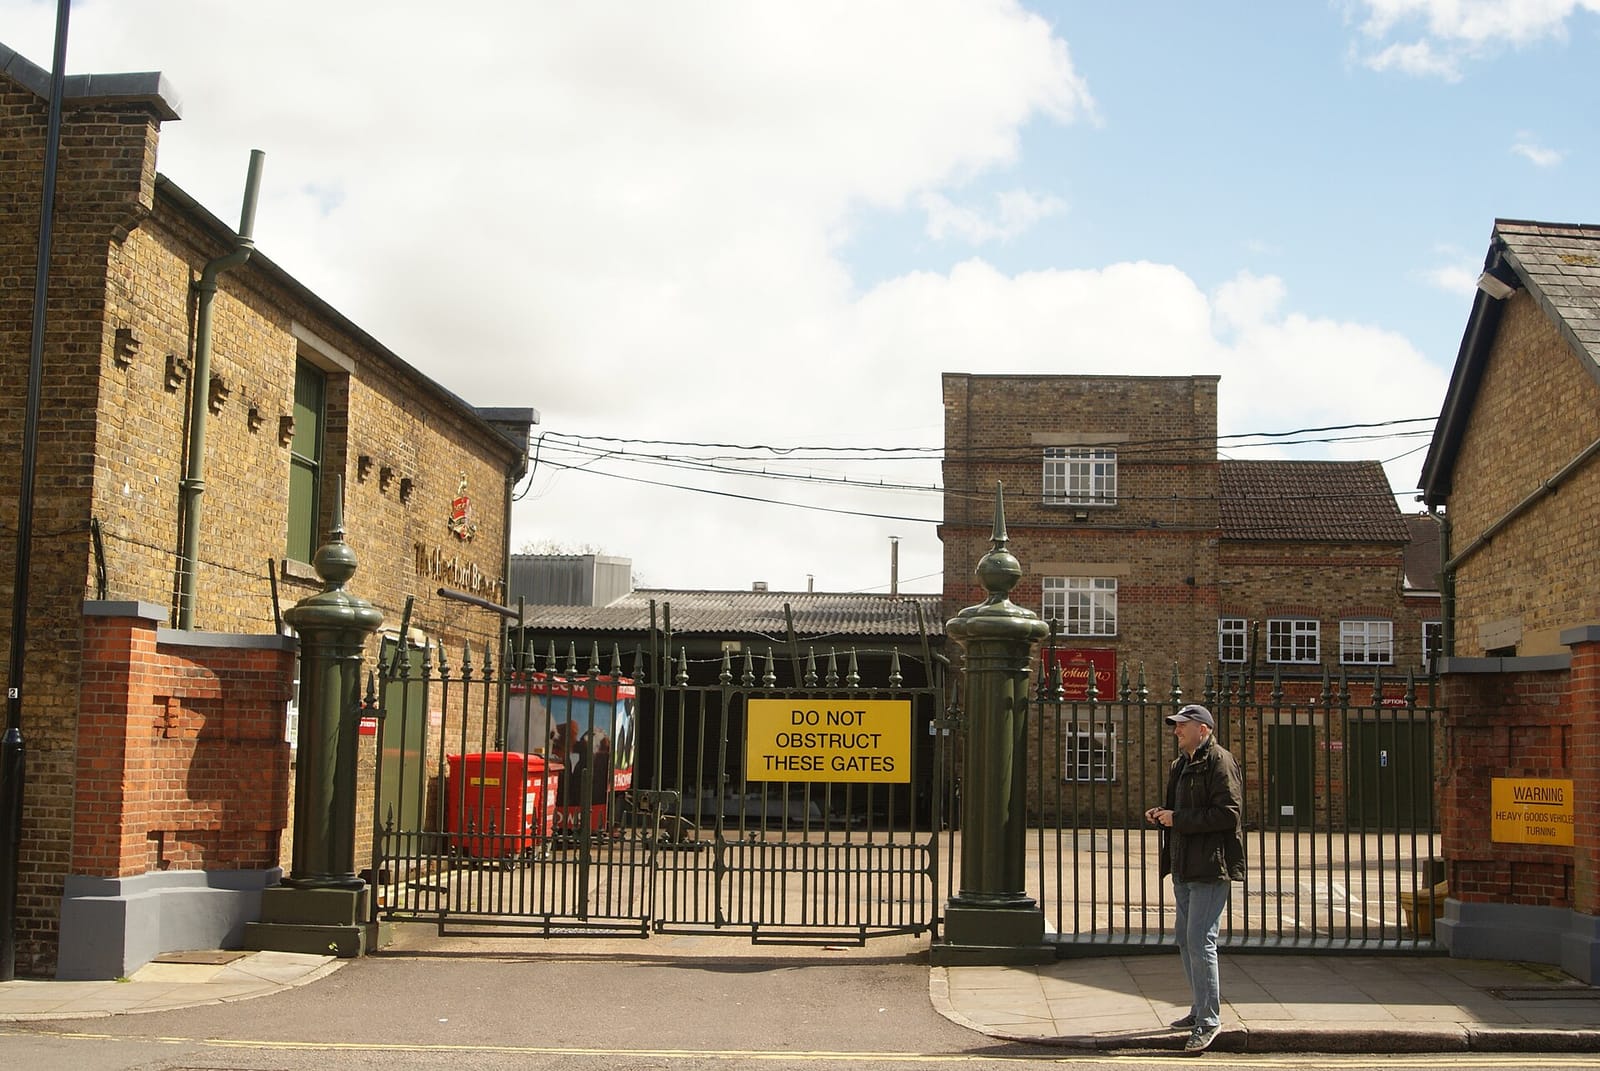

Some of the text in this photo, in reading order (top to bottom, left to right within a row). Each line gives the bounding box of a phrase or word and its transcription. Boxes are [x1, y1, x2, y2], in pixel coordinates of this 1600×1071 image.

[791, 710, 866, 726] DO NOT
[776, 733, 882, 749] OBSTRUCT
[763, 755, 895, 772] THESE GATES
[1513, 786, 1564, 802] WARNING
[1495, 811, 1522, 821] HEAVY
[1524, 812, 1549, 823] GOODS
[1525, 825, 1556, 837] TURNING
